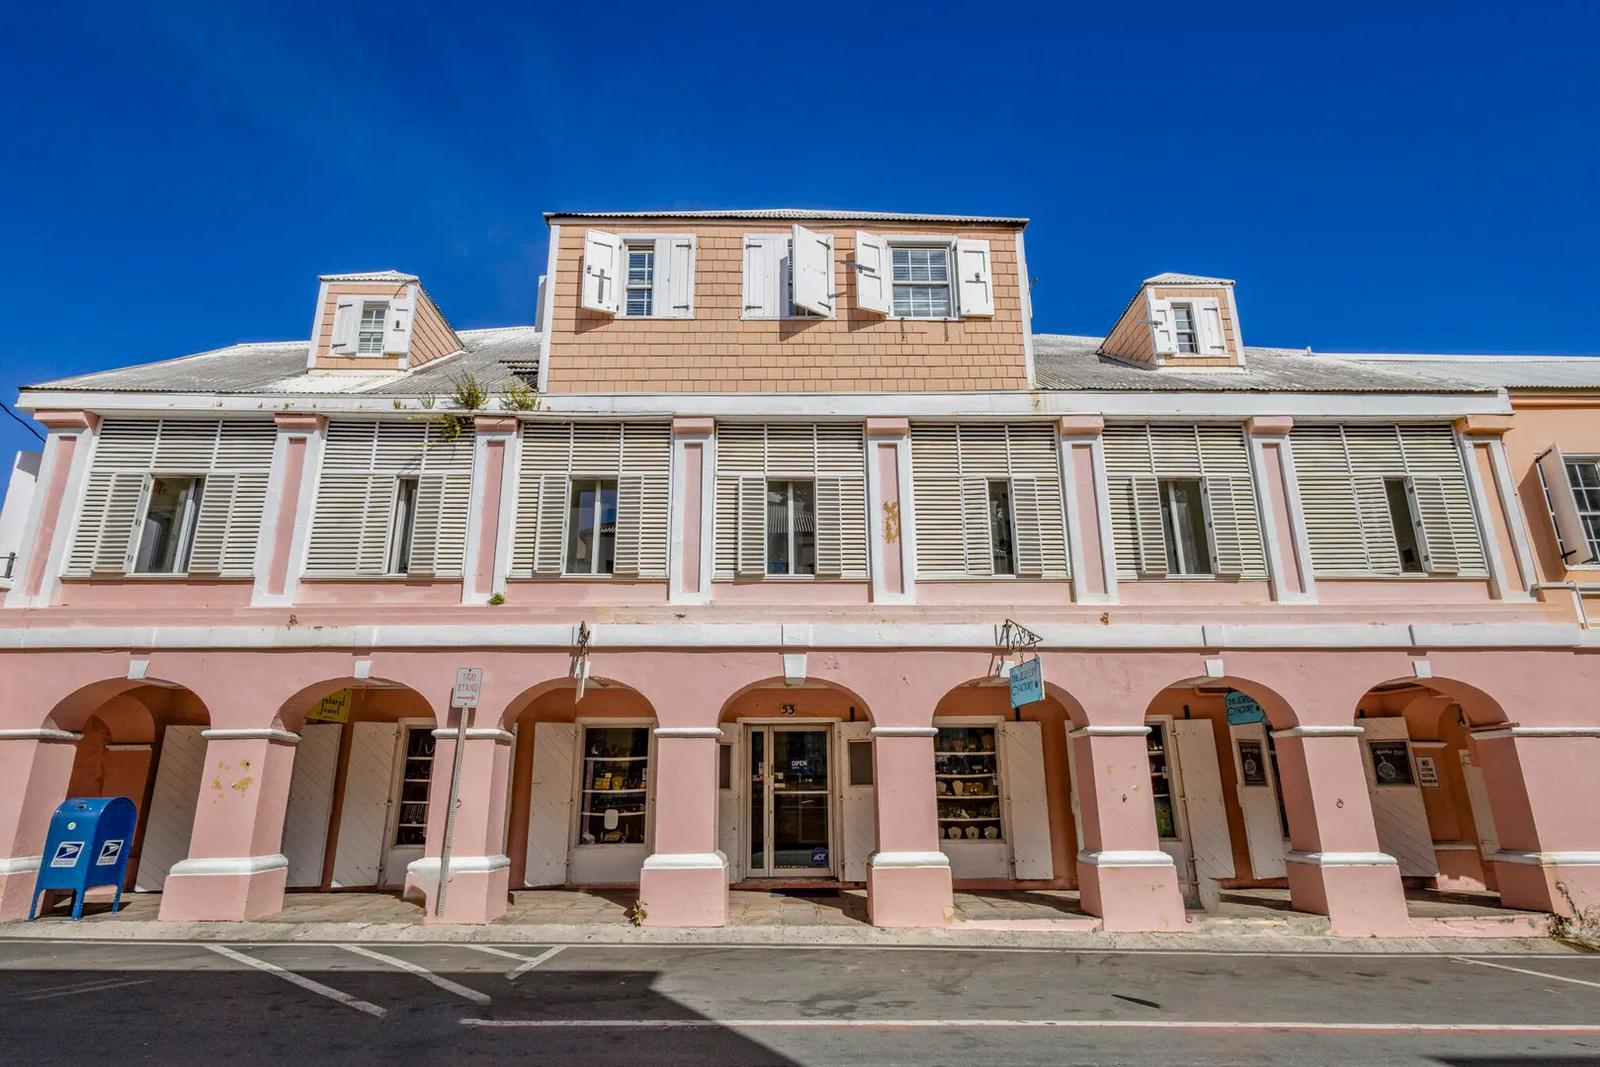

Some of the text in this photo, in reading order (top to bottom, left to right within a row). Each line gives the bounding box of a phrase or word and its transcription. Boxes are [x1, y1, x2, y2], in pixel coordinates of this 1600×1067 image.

[458, 683, 479, 692] STAND
[780, 704, 795, 715] 53
[813, 853, 826, 861] ADT
